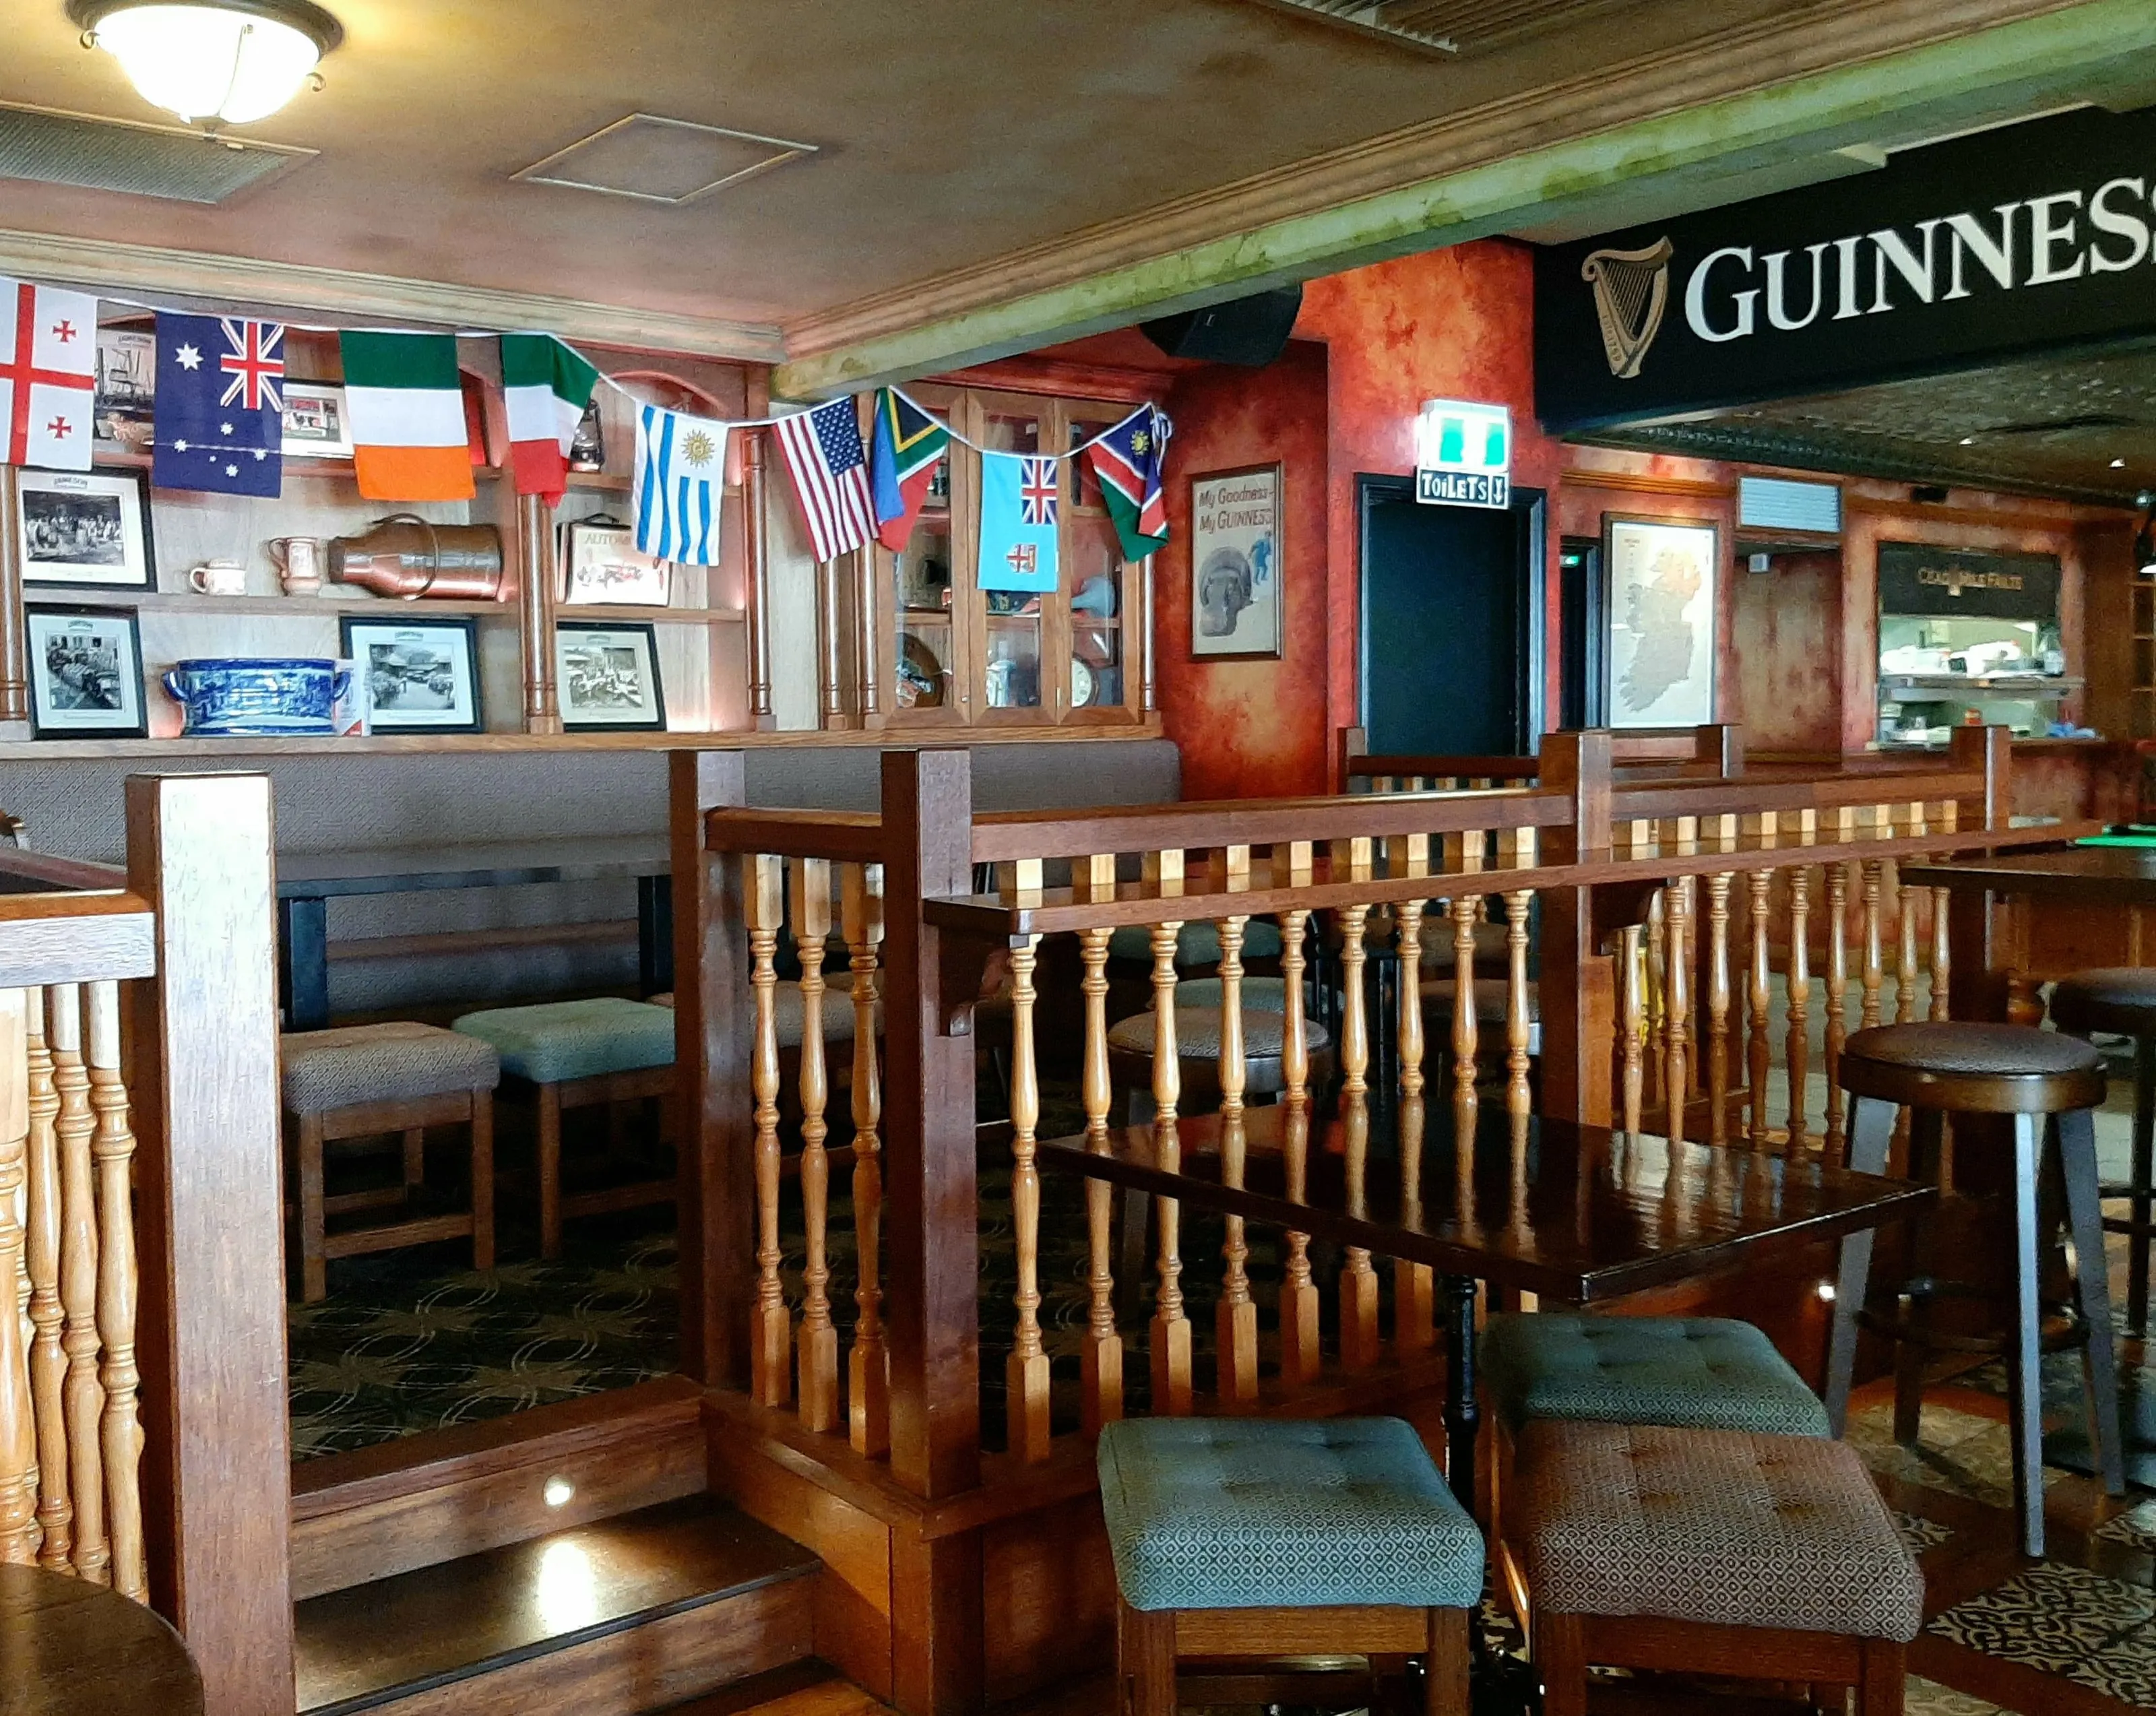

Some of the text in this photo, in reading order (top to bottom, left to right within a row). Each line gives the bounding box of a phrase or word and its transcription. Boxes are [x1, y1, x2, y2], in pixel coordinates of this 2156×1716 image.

[1684, 177, 2156, 342] GUINNES
[1199, 490, 1215, 509] My
[1199, 514, 1215, 534] My
